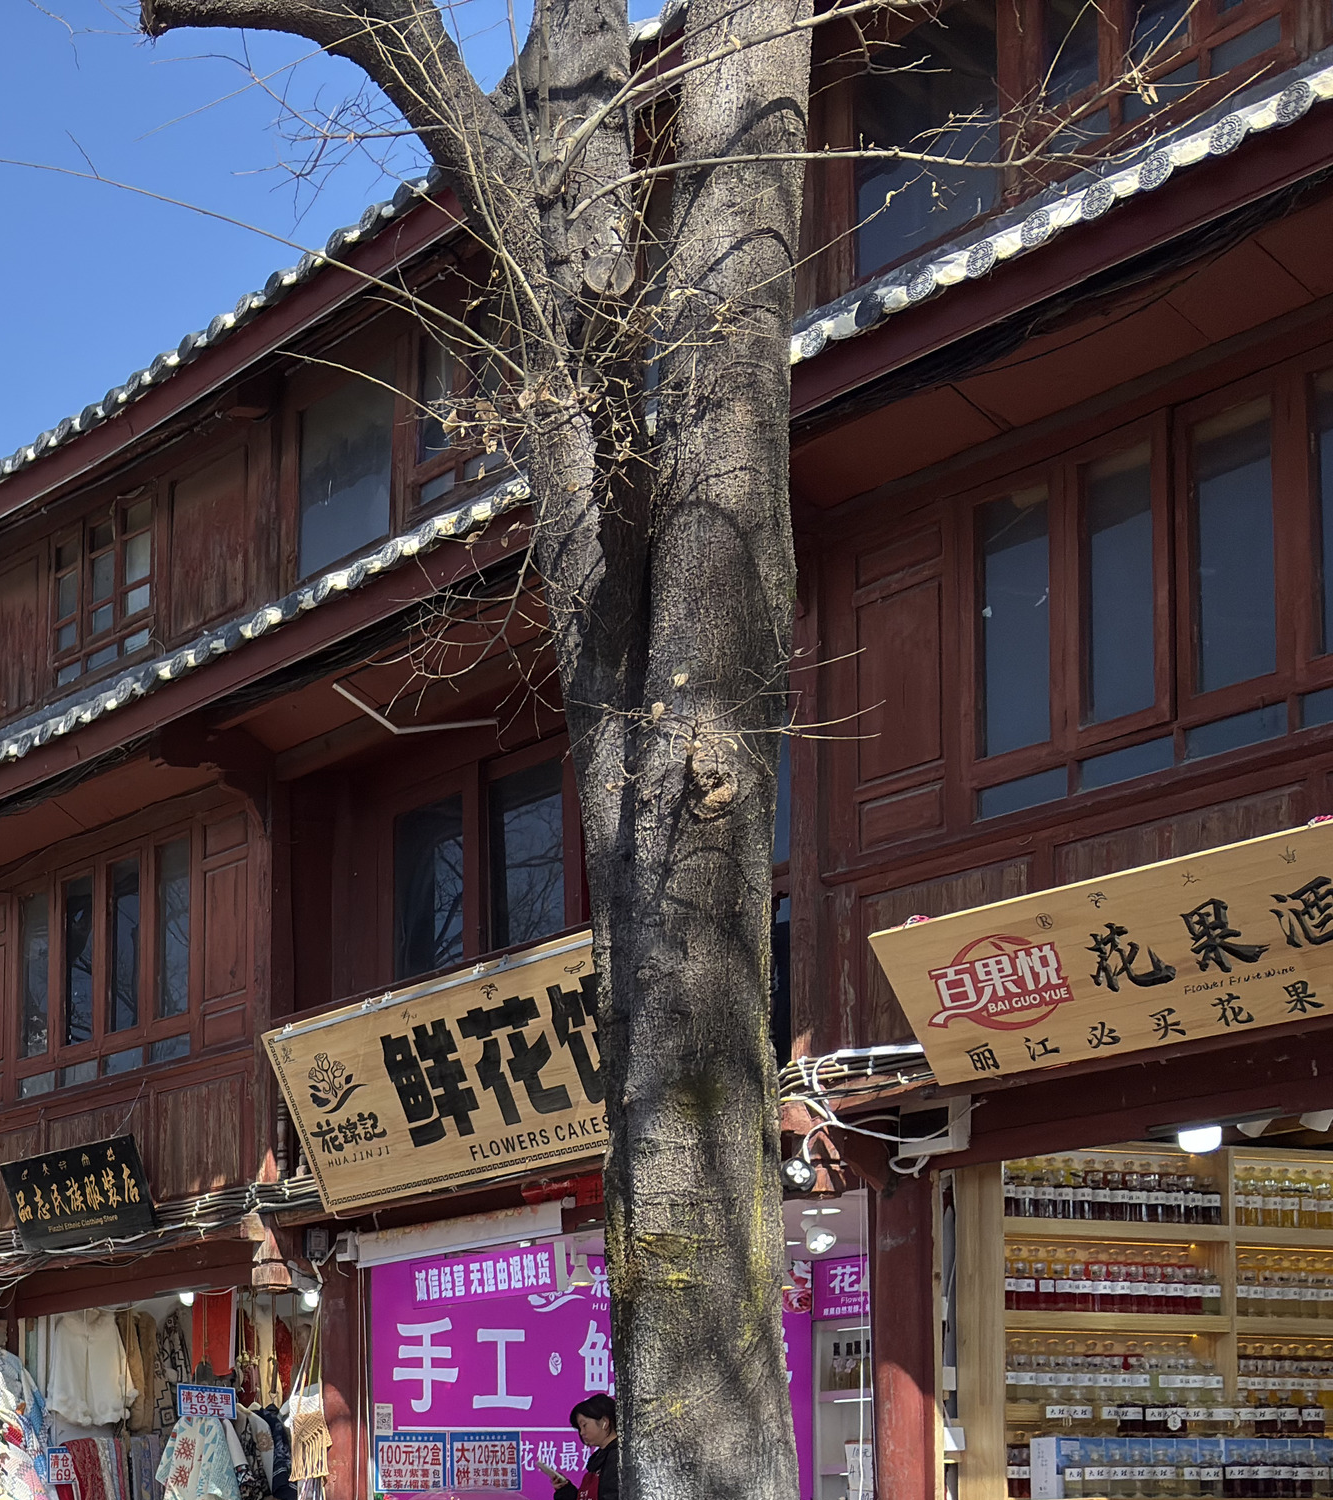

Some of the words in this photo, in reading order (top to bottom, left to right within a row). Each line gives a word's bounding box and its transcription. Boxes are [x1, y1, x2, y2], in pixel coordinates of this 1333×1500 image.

[931, 944, 1063, 1024] 百果悦
[987, 1000, 1010, 1013] BAI
[1012, 993, 1040, 1009] GUO
[1041, 987, 1070, 1002] YUE
[309, 1111, 388, 1155] 花锦记
[469, 1129, 551, 1162] FLOWERS
[555, 1115, 611, 1142] CAKES
[81, 1217, 104, 1228] Clothing
[104, 1214, 119, 1223] Store
[415, 1264, 465, 1301] 诚信经营
[470, 1251, 551, 1295] 无理由退换货
[181, 1390, 232, 1406] 清仓处理
[189, 1403, 225, 1417] 59元
[379, 1443, 442, 1466] 100元12盒
[471, 1444, 518, 1466] 120元8盒
